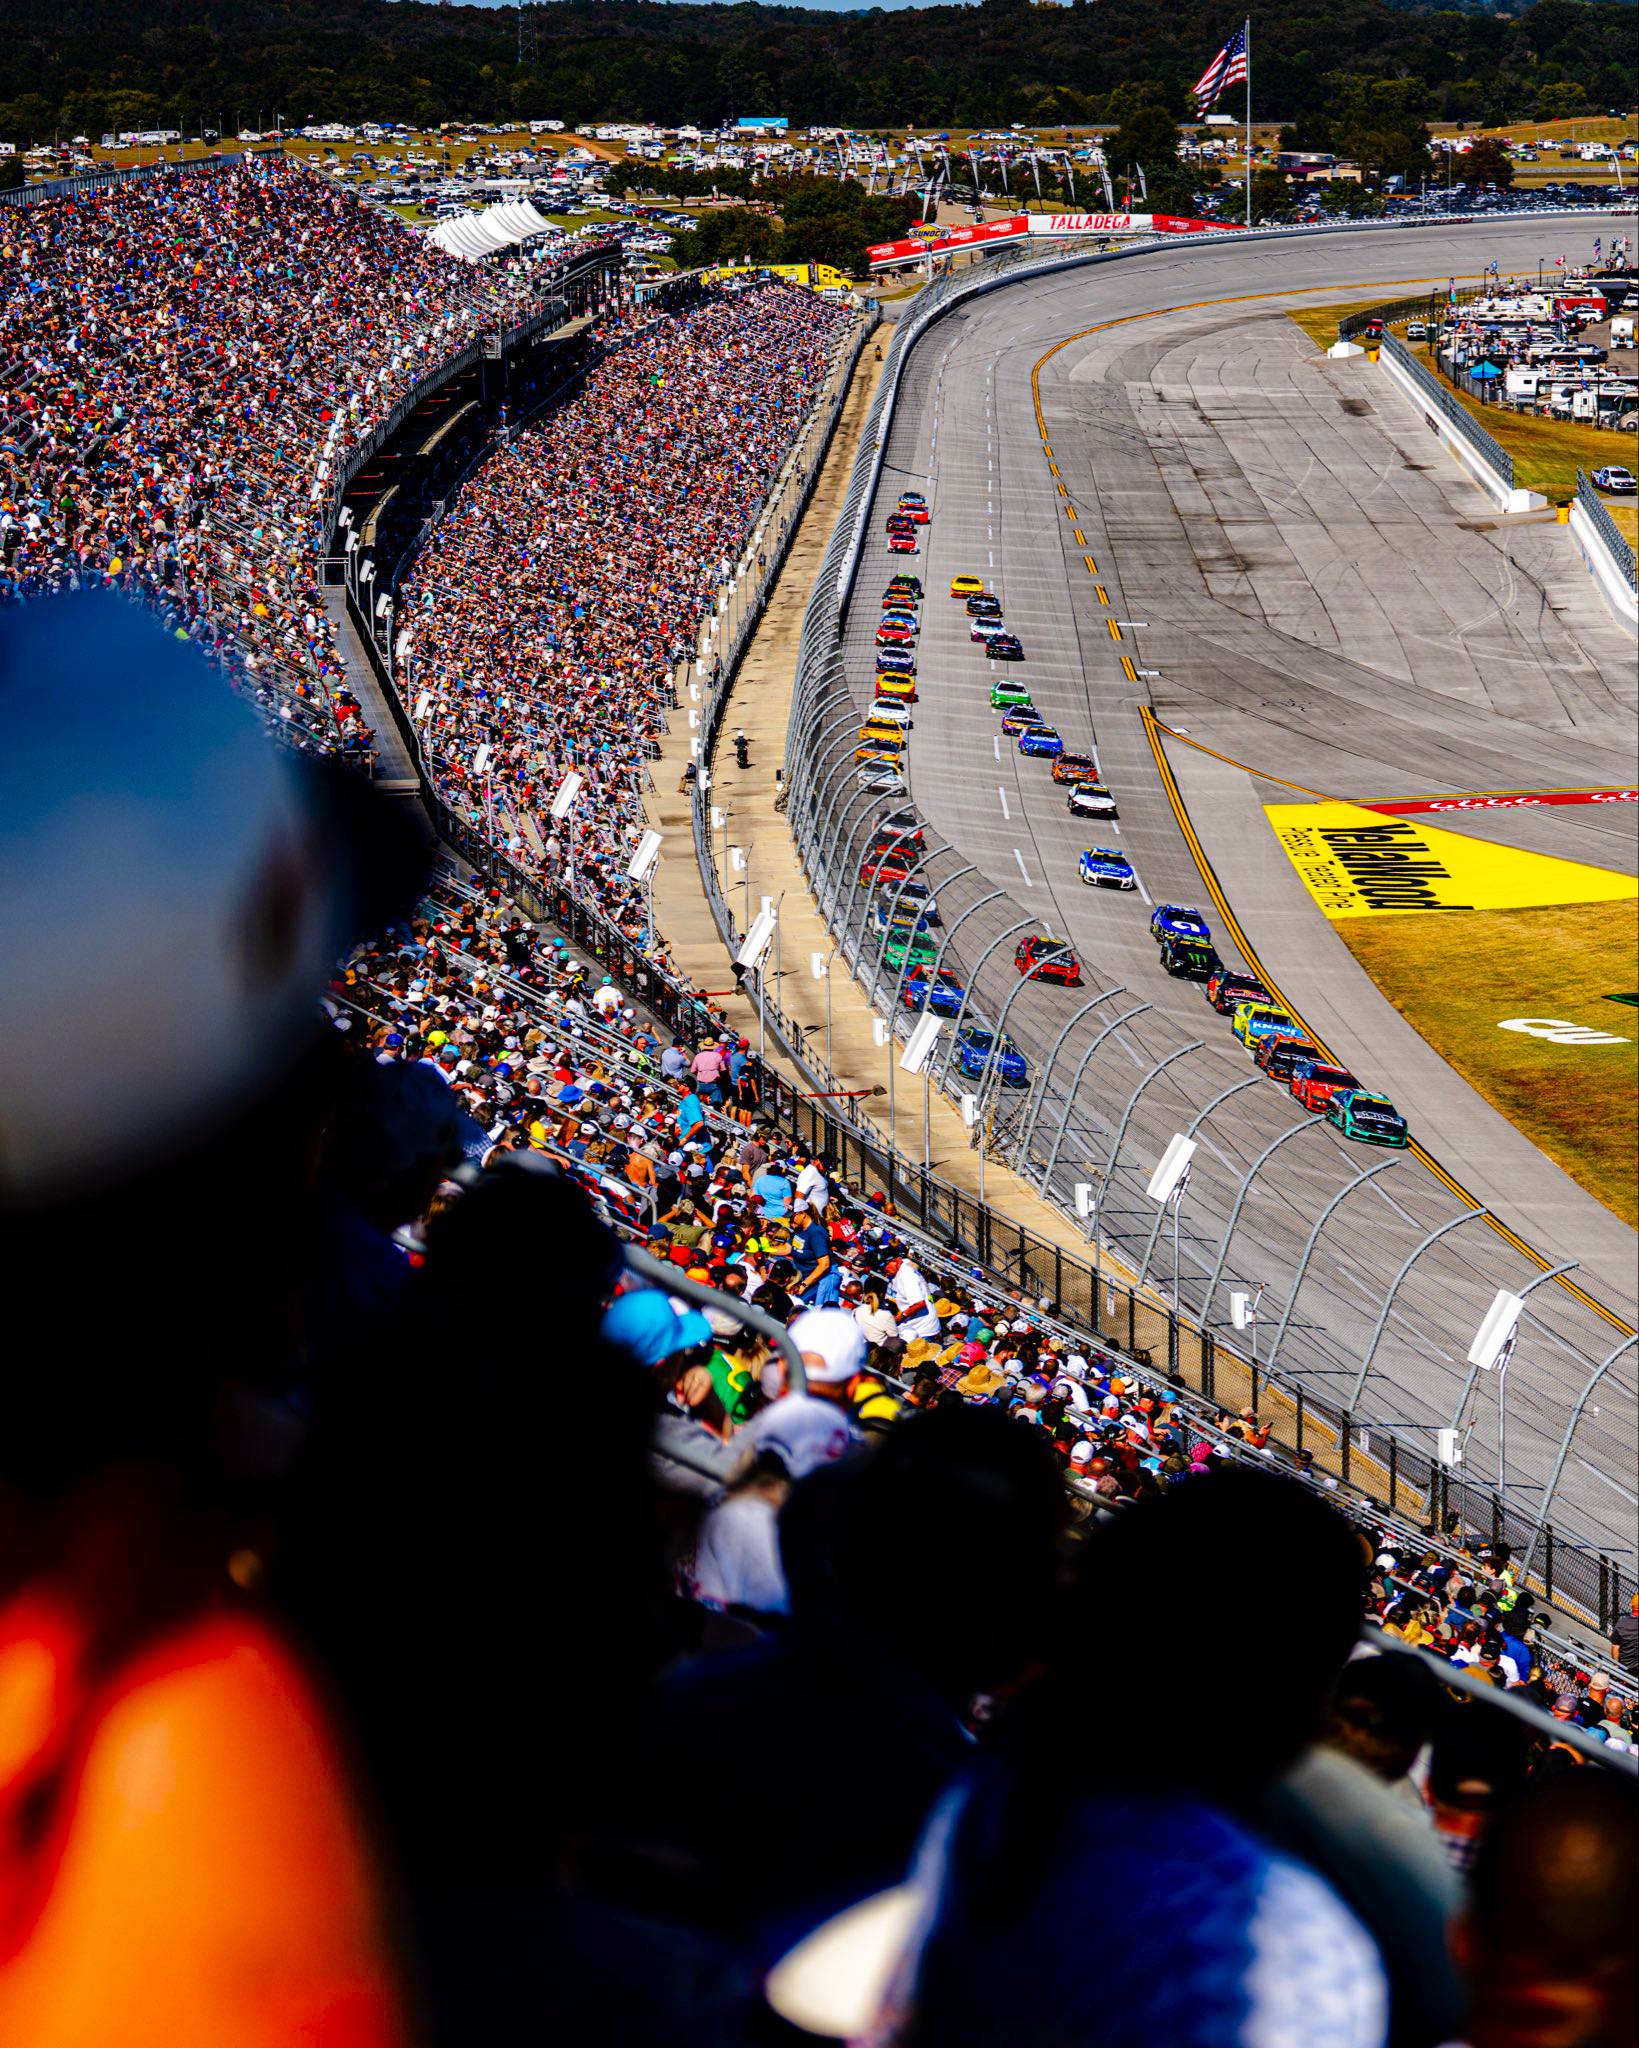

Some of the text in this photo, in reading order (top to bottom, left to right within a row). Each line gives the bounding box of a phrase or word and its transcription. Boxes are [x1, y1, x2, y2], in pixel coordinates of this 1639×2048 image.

[1050, 214, 1131, 230] TALLADEGA
[912, 230, 947, 238] SUNOCO
[1317, 822, 1475, 911] YellaWood
[1315, 891, 1357, 909] Pine
